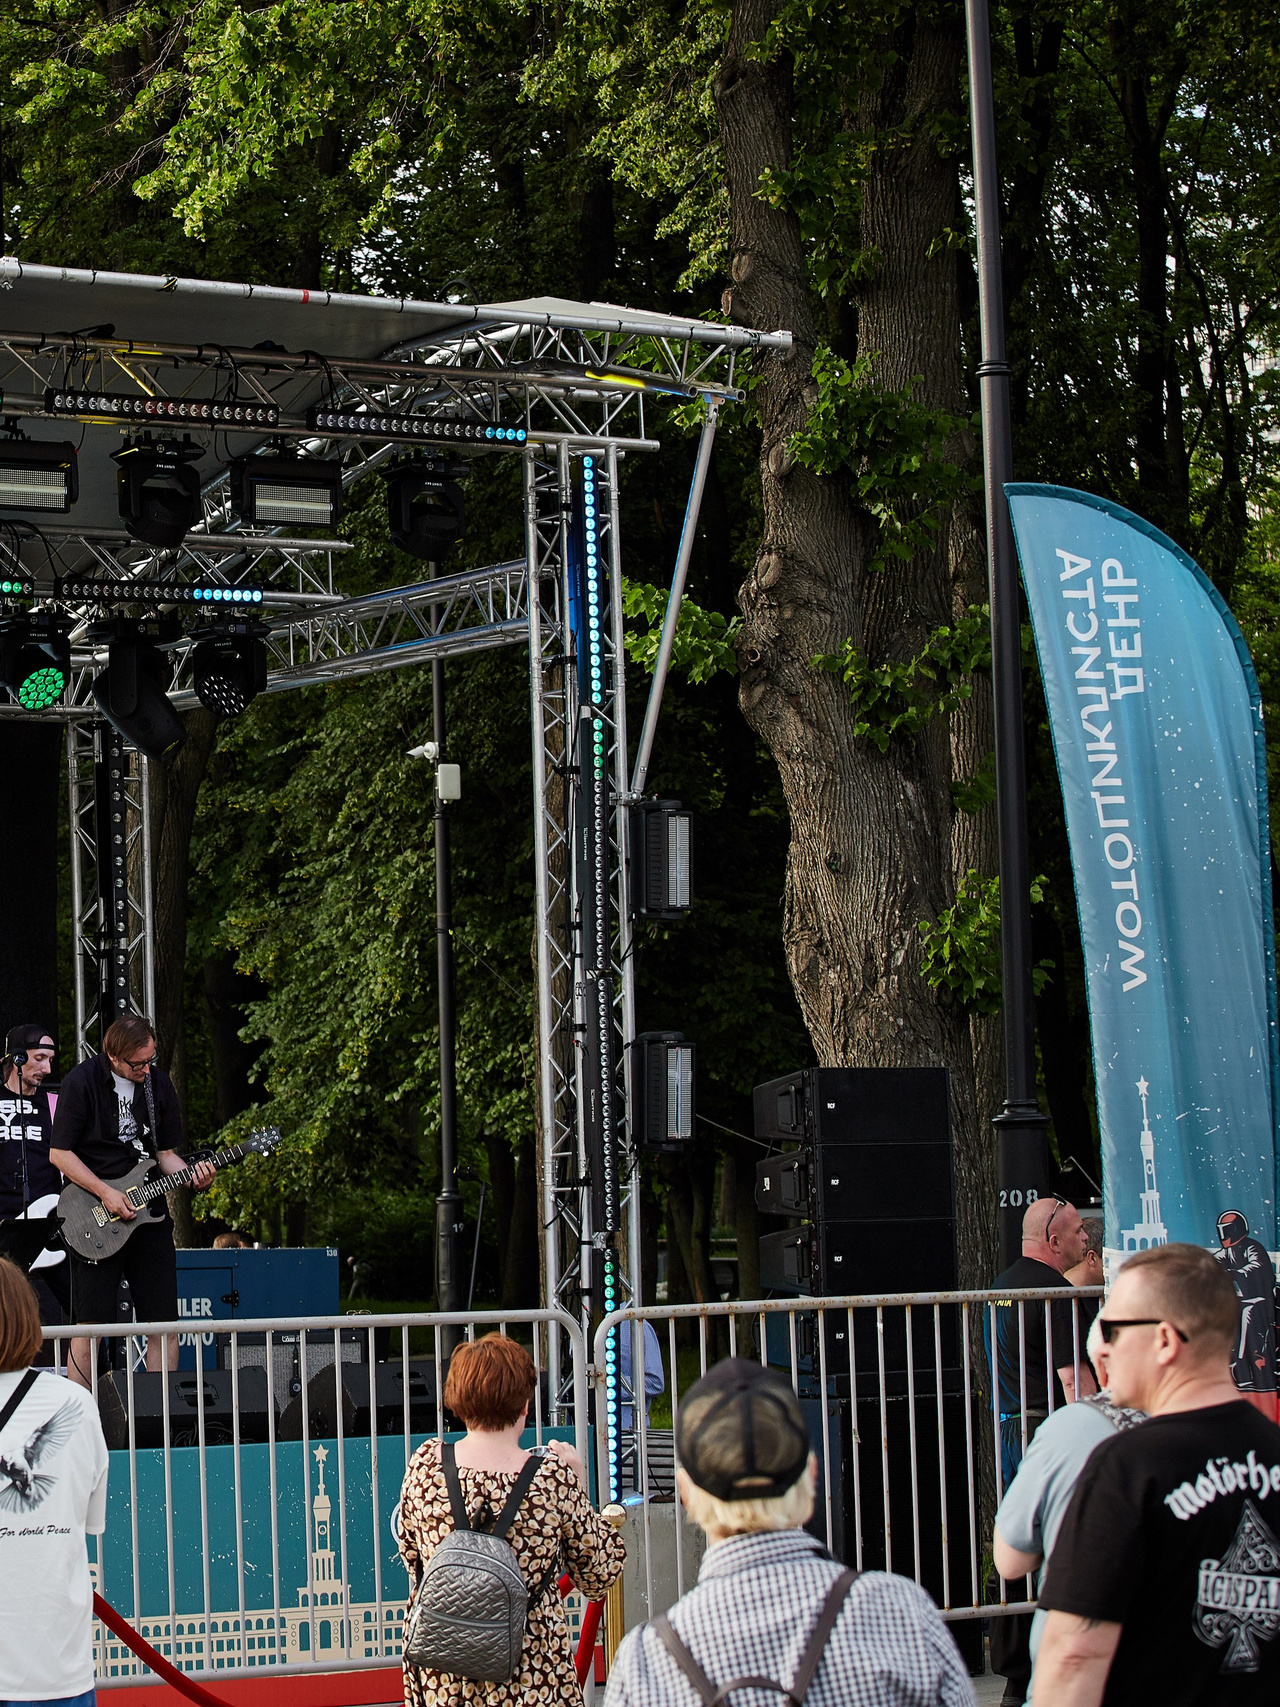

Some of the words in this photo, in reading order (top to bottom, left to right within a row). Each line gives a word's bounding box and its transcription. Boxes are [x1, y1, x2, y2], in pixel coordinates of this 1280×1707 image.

[999, 1188, 1038, 1207] 208
[0, 1527, 16, 1538] For
[18, 1526, 45, 1536] World
[46, 1524, 72, 1535] Peace
